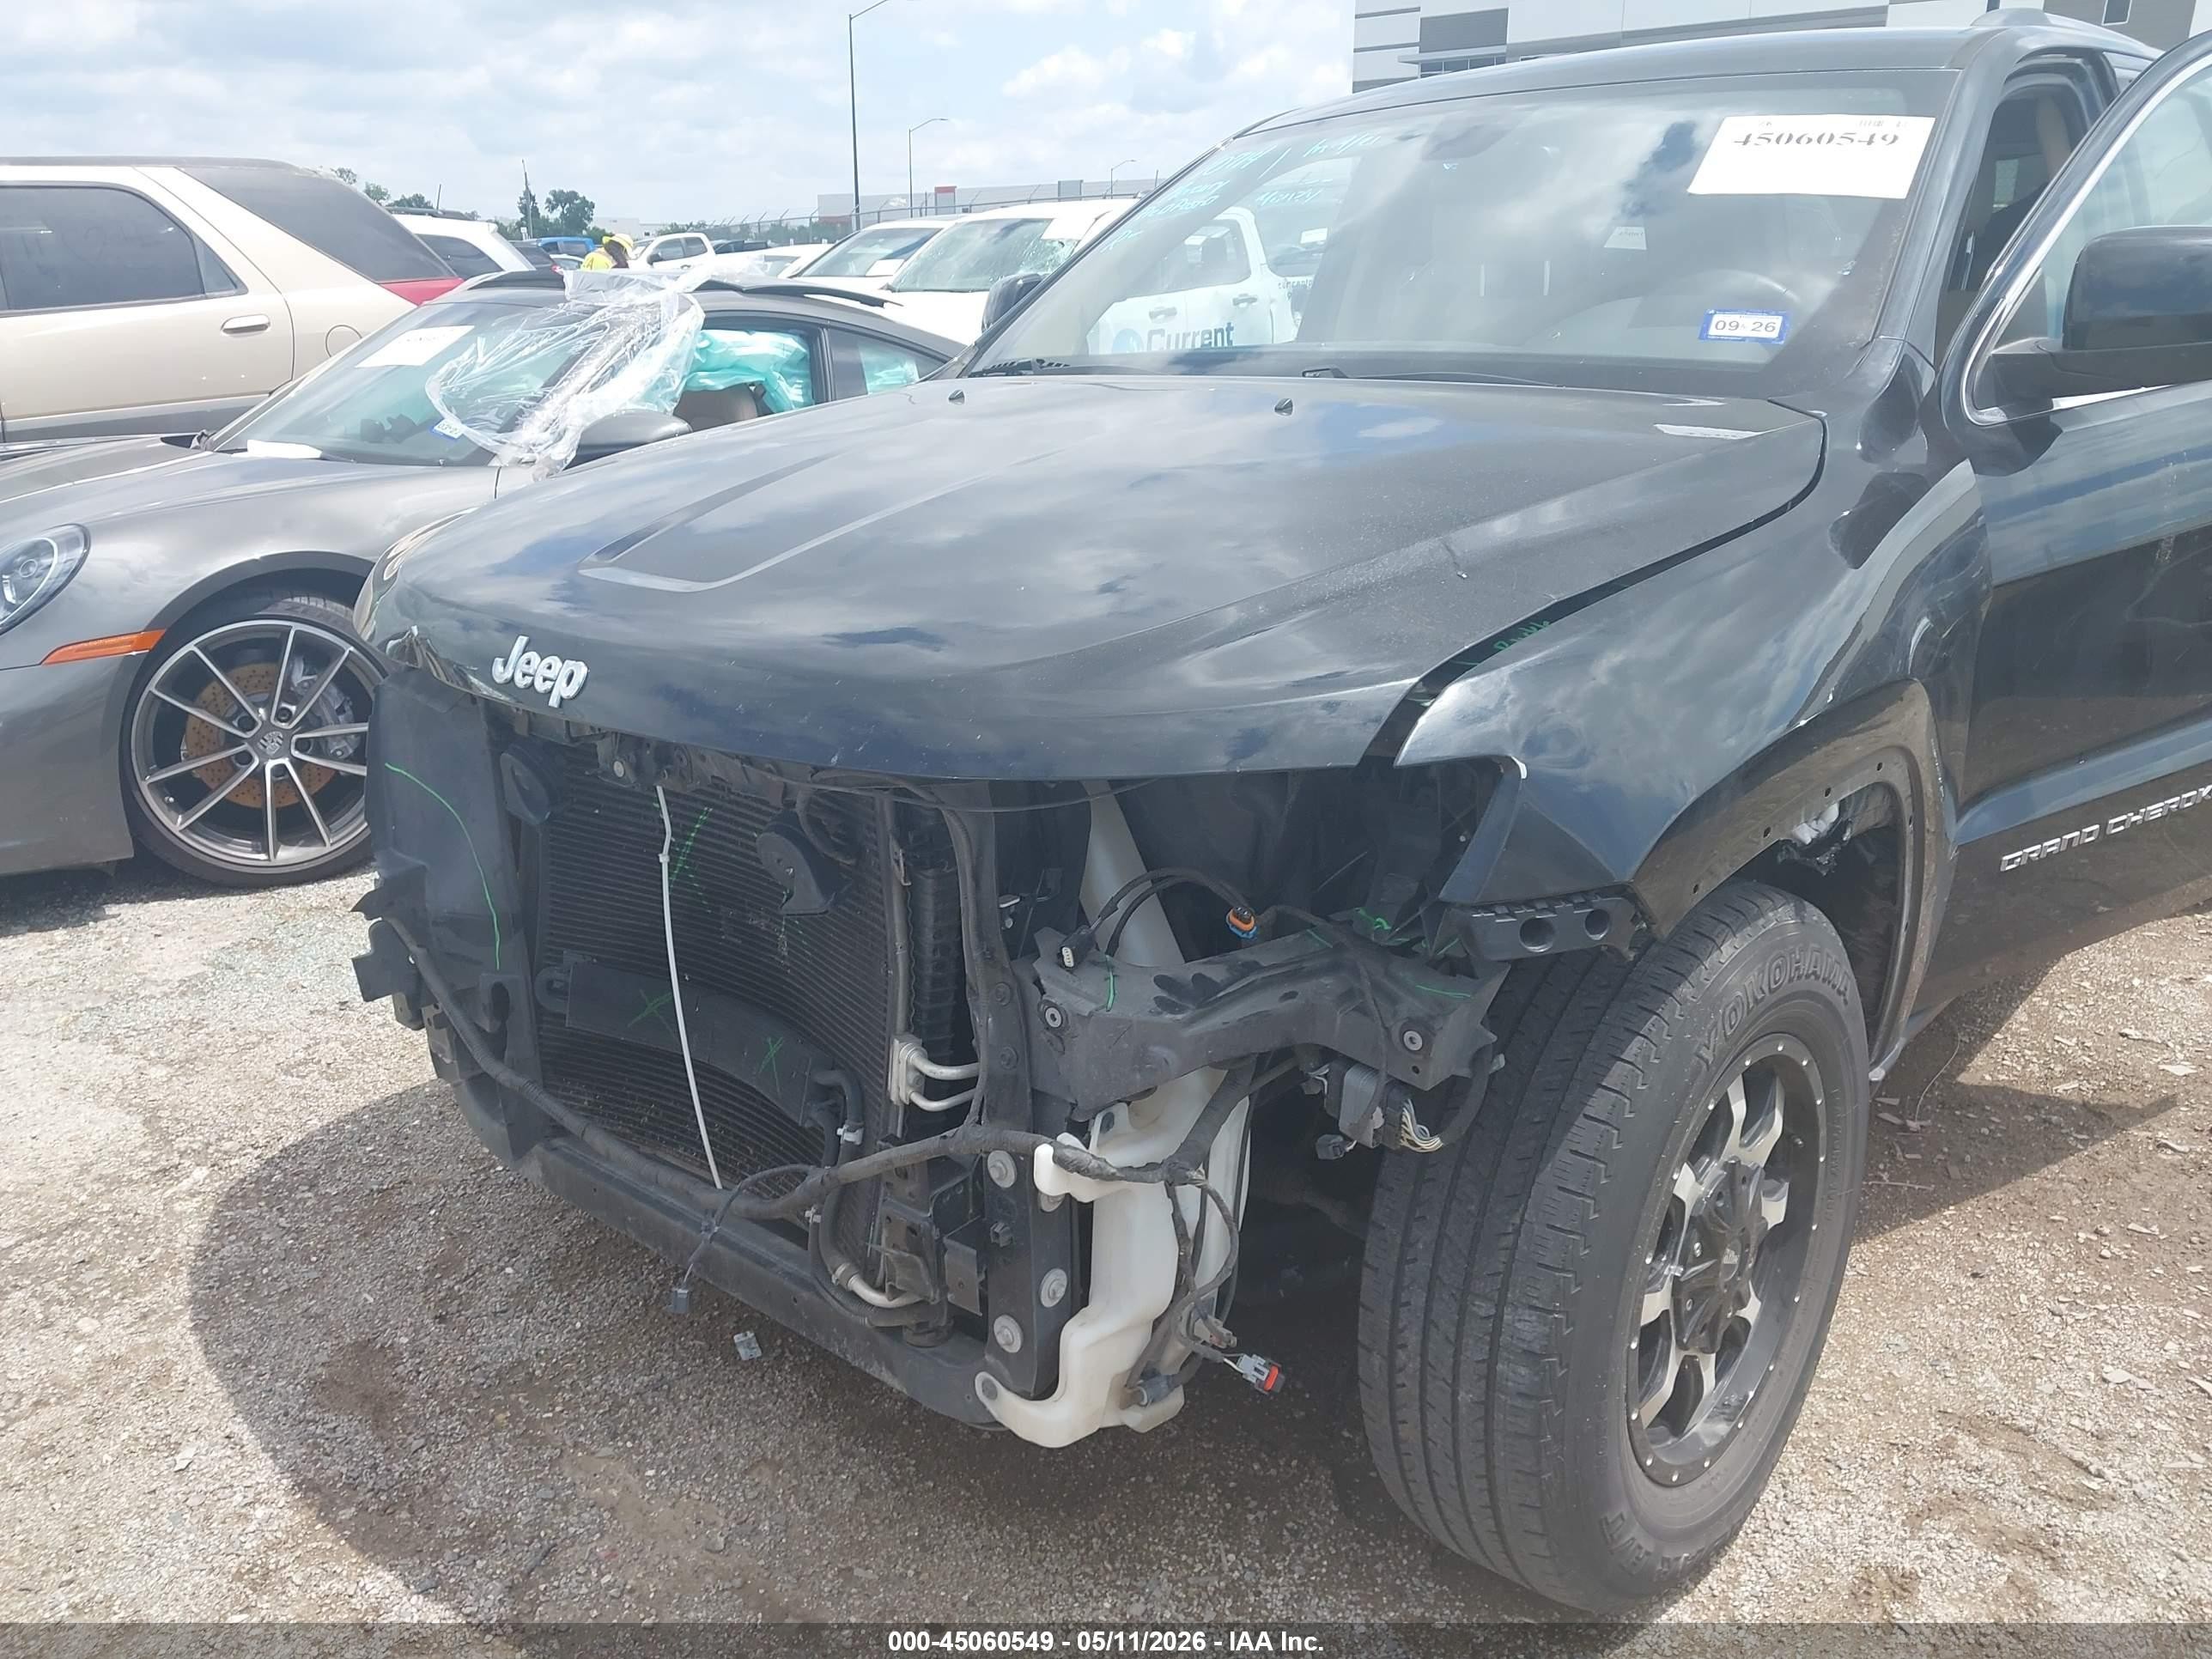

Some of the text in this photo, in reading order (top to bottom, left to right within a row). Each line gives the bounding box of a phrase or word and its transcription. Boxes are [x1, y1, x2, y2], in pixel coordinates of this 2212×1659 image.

[1731, 132, 1899, 146] 45060549
[1146, 321, 1235, 351] Current
[1714, 319, 1777, 332] 09 26
[491, 635, 588, 708] Jeep
[1999, 823, 2100, 872] GRAND
[1695, 945, 1851, 1072] YOKOHAMA
